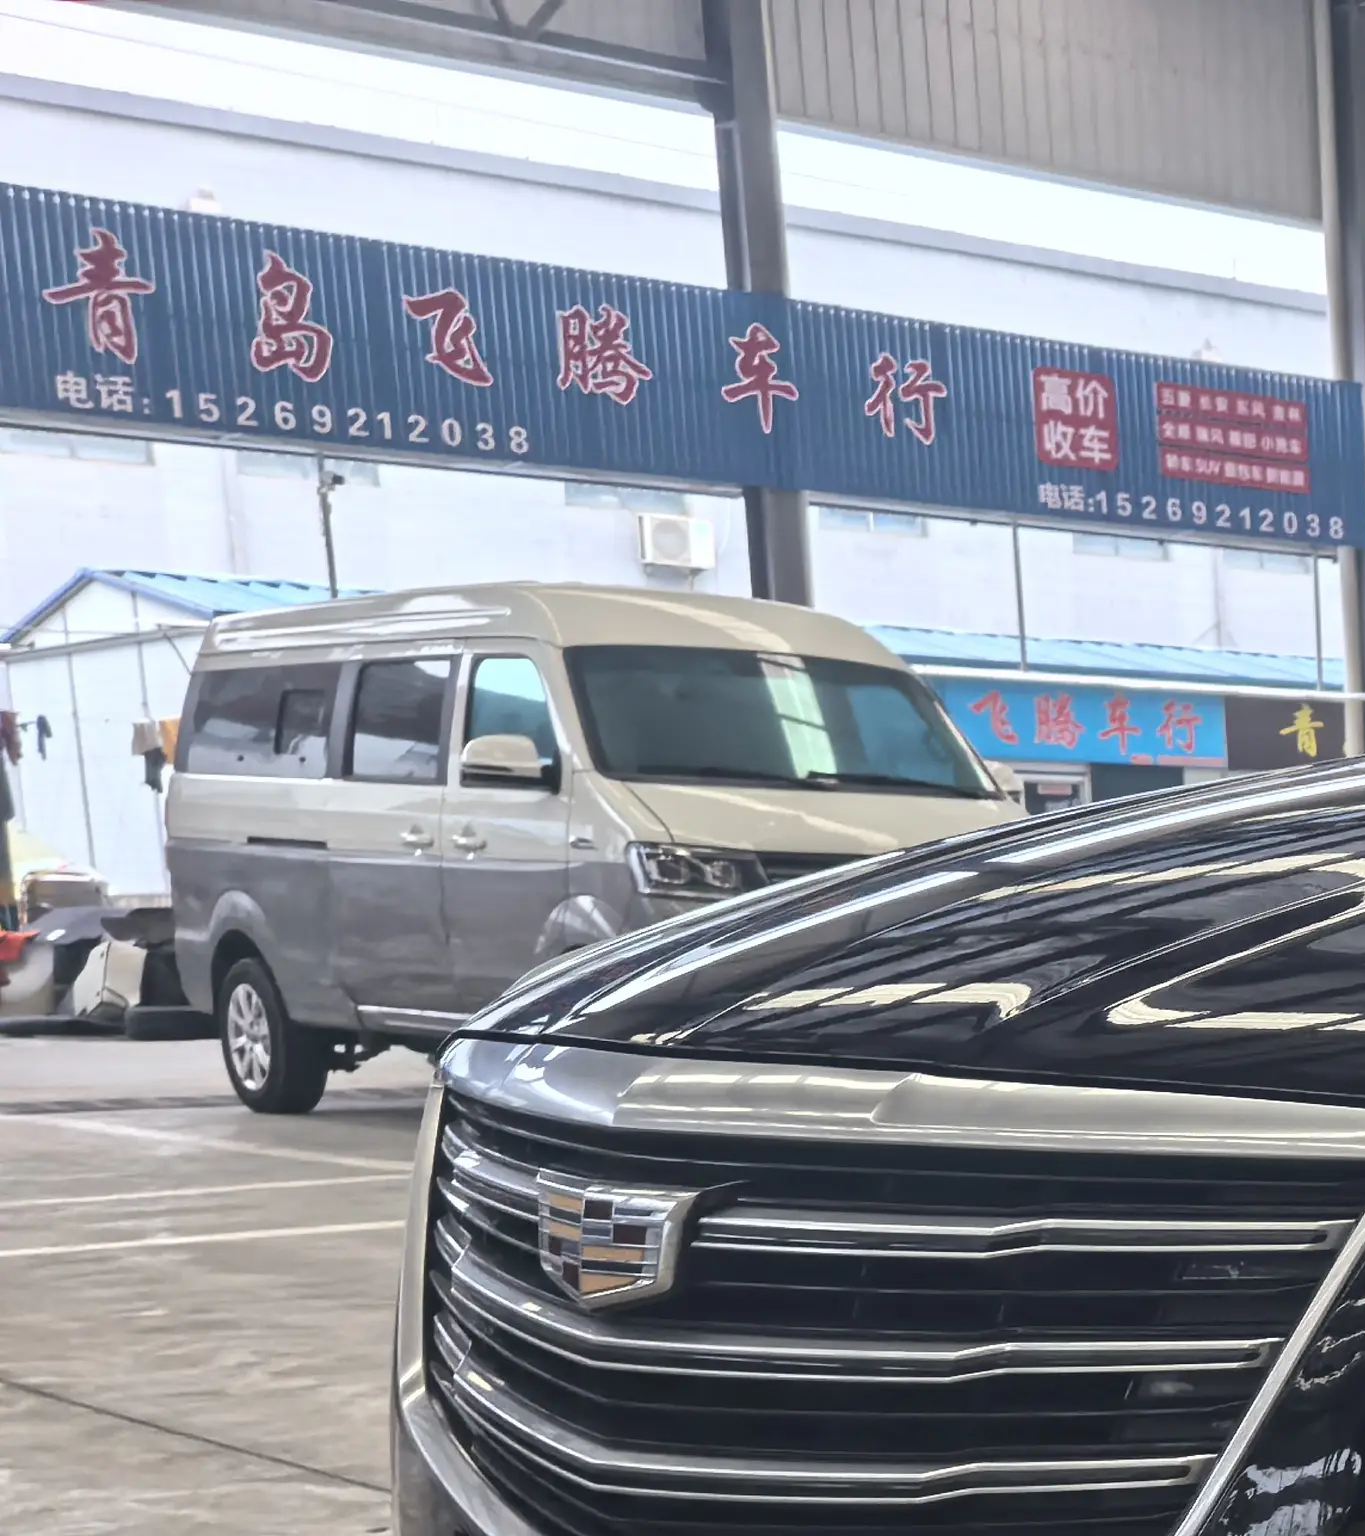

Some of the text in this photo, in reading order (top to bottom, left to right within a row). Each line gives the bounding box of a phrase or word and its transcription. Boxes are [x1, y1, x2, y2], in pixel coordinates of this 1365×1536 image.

[43, 226, 947, 445] 青岛飞腾车行
[55, 370, 530, 455] 电话:15269212038
[1040, 374, 1109, 420] 高价
[1043, 420, 1112, 465] 收车
[1038, 482, 1345, 540] 电话:15269212038
[968, 688, 1203, 756] 飞腾车行
